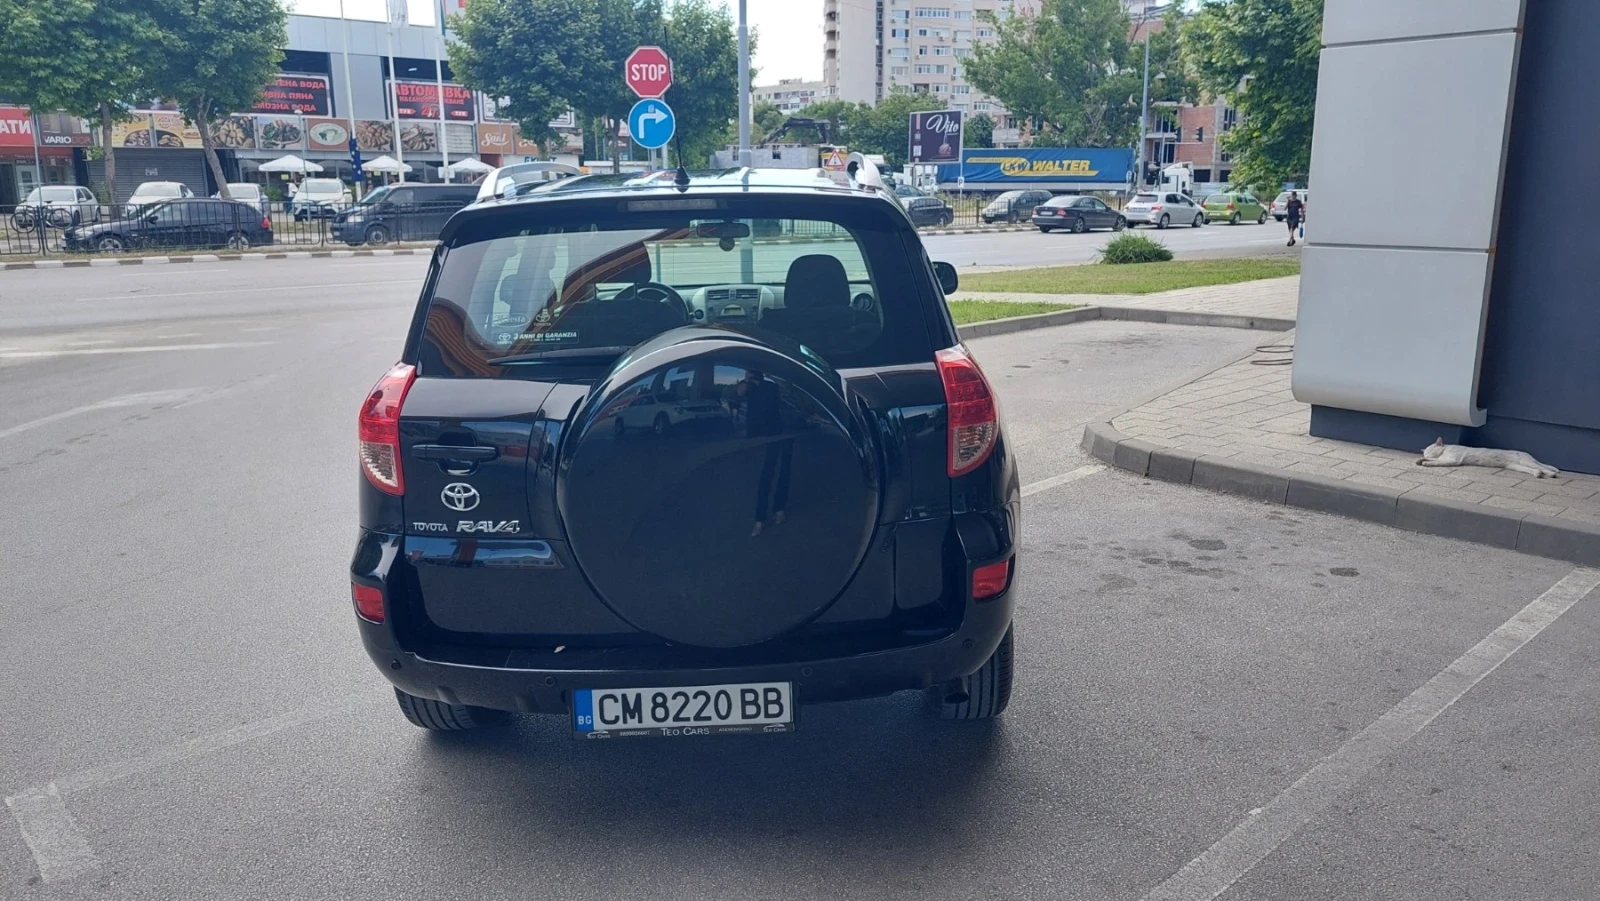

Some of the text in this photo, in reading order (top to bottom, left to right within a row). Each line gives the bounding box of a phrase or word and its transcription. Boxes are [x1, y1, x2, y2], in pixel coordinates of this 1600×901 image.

[631, 64, 667, 81] STOP
[300, 81, 324, 89] ВОДА
[395, 84, 471, 99] АВТОМВКА
[289, 92, 314, 100] ПЯНА
[926, 114, 959, 133] Vito
[1032, 160, 1090, 172] WALTER
[513, 332, 519, 340] 3
[519, 332, 535, 340] ANNI
[413, 520, 520, 534] TOYOTA RAV4
[599, 687, 784, 725] CM 8220 BB
[577, 715, 592, 725] BG
